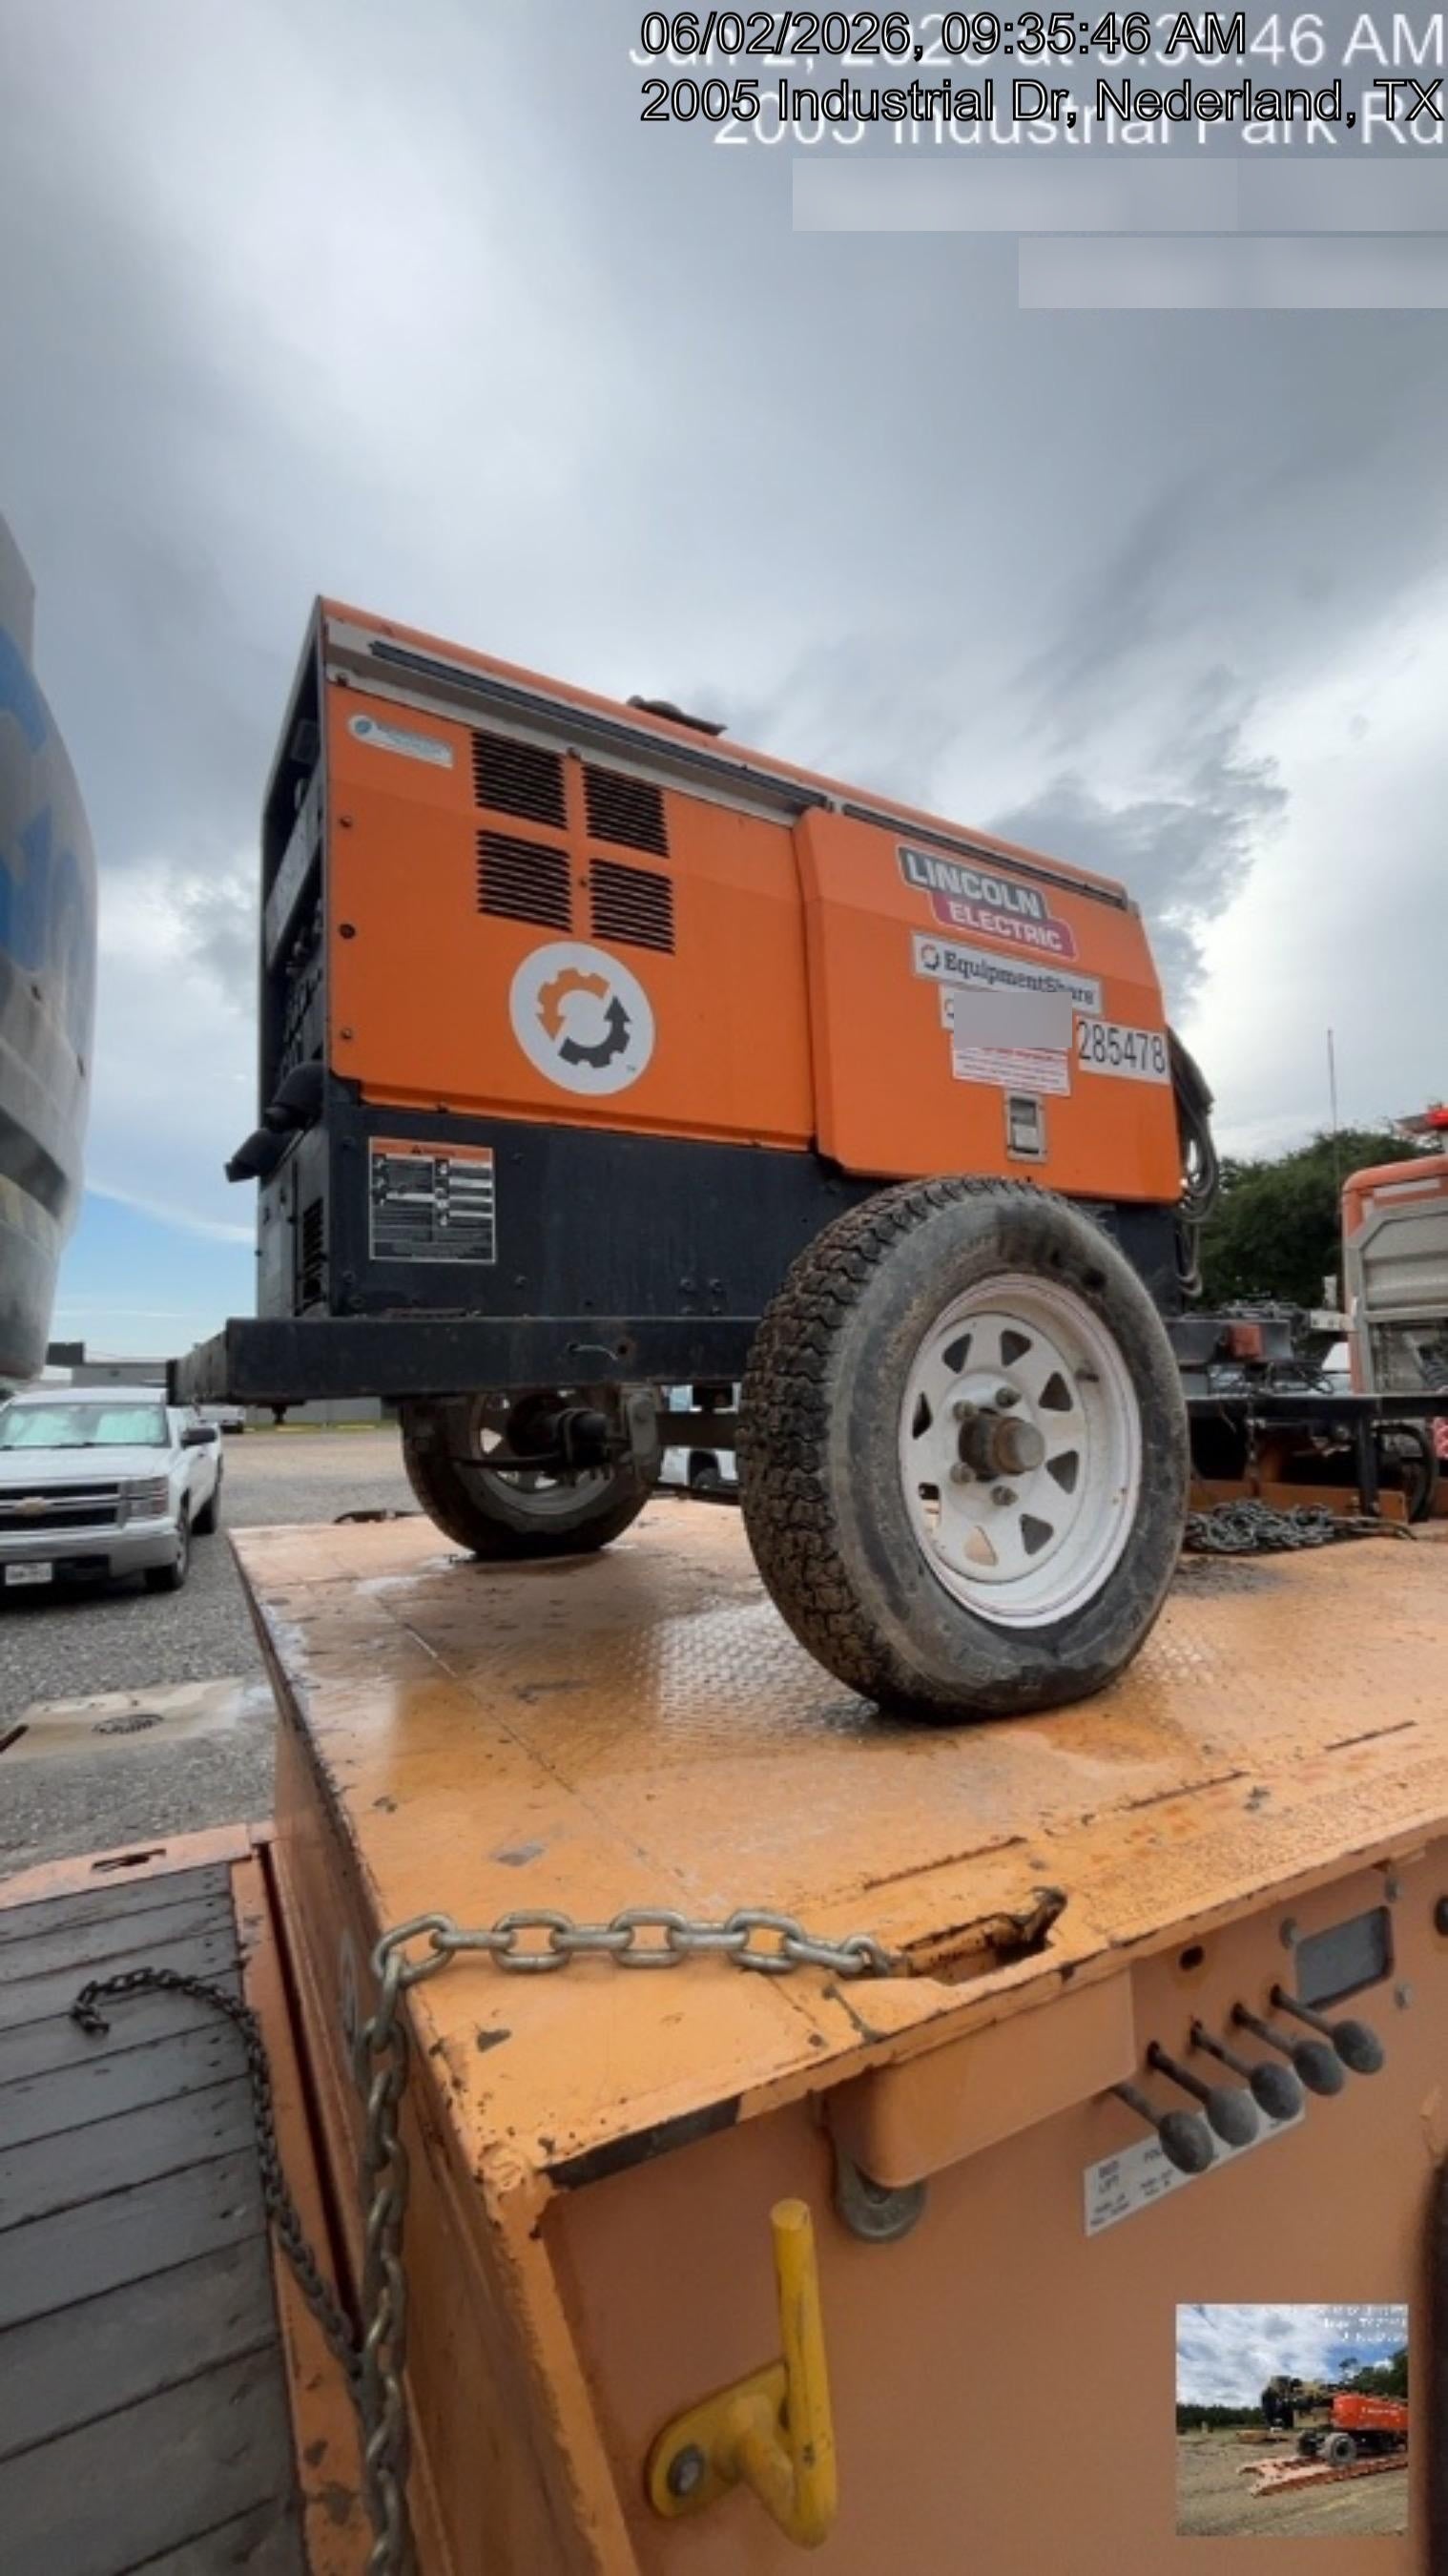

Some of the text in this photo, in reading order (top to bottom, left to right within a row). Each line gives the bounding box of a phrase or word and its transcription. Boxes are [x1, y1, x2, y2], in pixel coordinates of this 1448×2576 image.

[906, 853, 1042, 917] LINCOLN
[946, 900, 1063, 950] ELECTRIC
[1078, 1021, 1166, 1073] 285478
